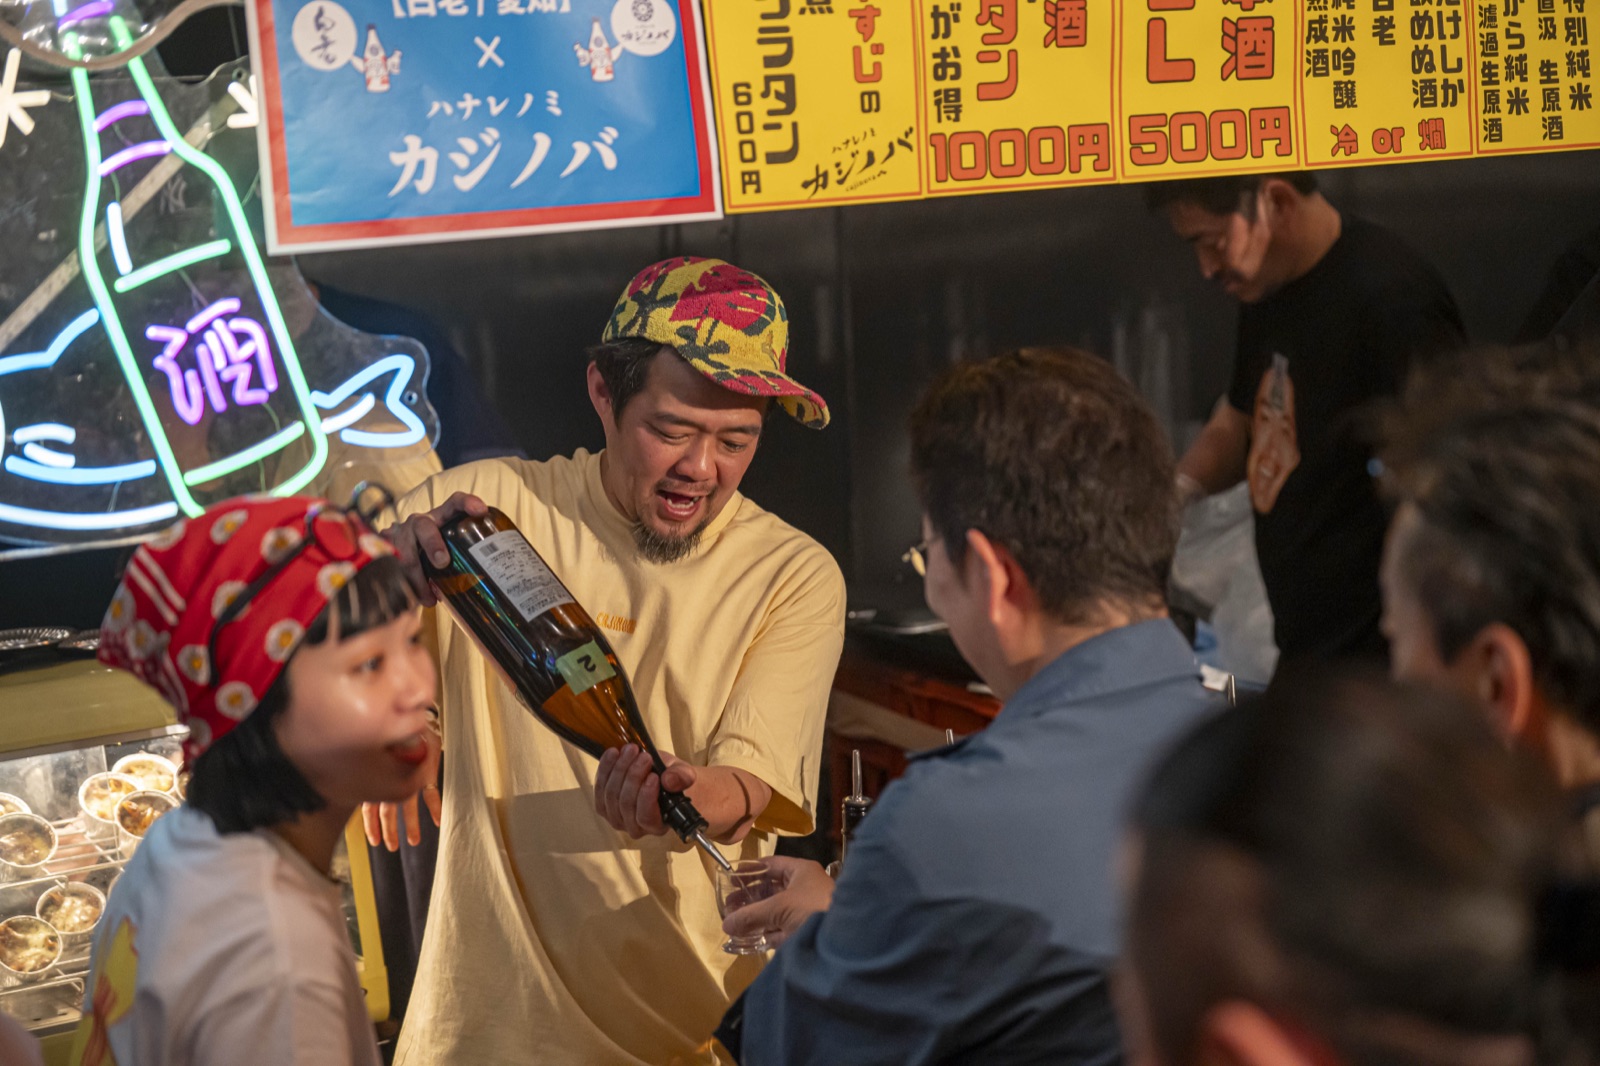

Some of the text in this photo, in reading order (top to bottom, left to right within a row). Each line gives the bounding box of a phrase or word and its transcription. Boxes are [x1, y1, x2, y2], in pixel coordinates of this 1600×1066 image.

[848, 0, 885, 114] すじの
[931, 2, 963, 124] がお得
[1044, 0, 1088, 49] 酒
[1220, 0, 1275, 82] 酒
[1409, 0, 1438, 109] めぬ酒
[1435, 0, 1466, 108] けしか
[426, 90, 563, 121] ハナレノミ
[733, 82, 762, 195] 600円
[1128, 105, 1293, 167] 500円
[1538, 58, 1564, 141] 生原酒
[387, 126, 620, 198] カジノバ
[801, 126, 915, 200] カジノバ
[929, 122, 1111, 183] 1000円
[1330, 123, 1359, 158] 冷
[1371, 126, 1406, 155] or
